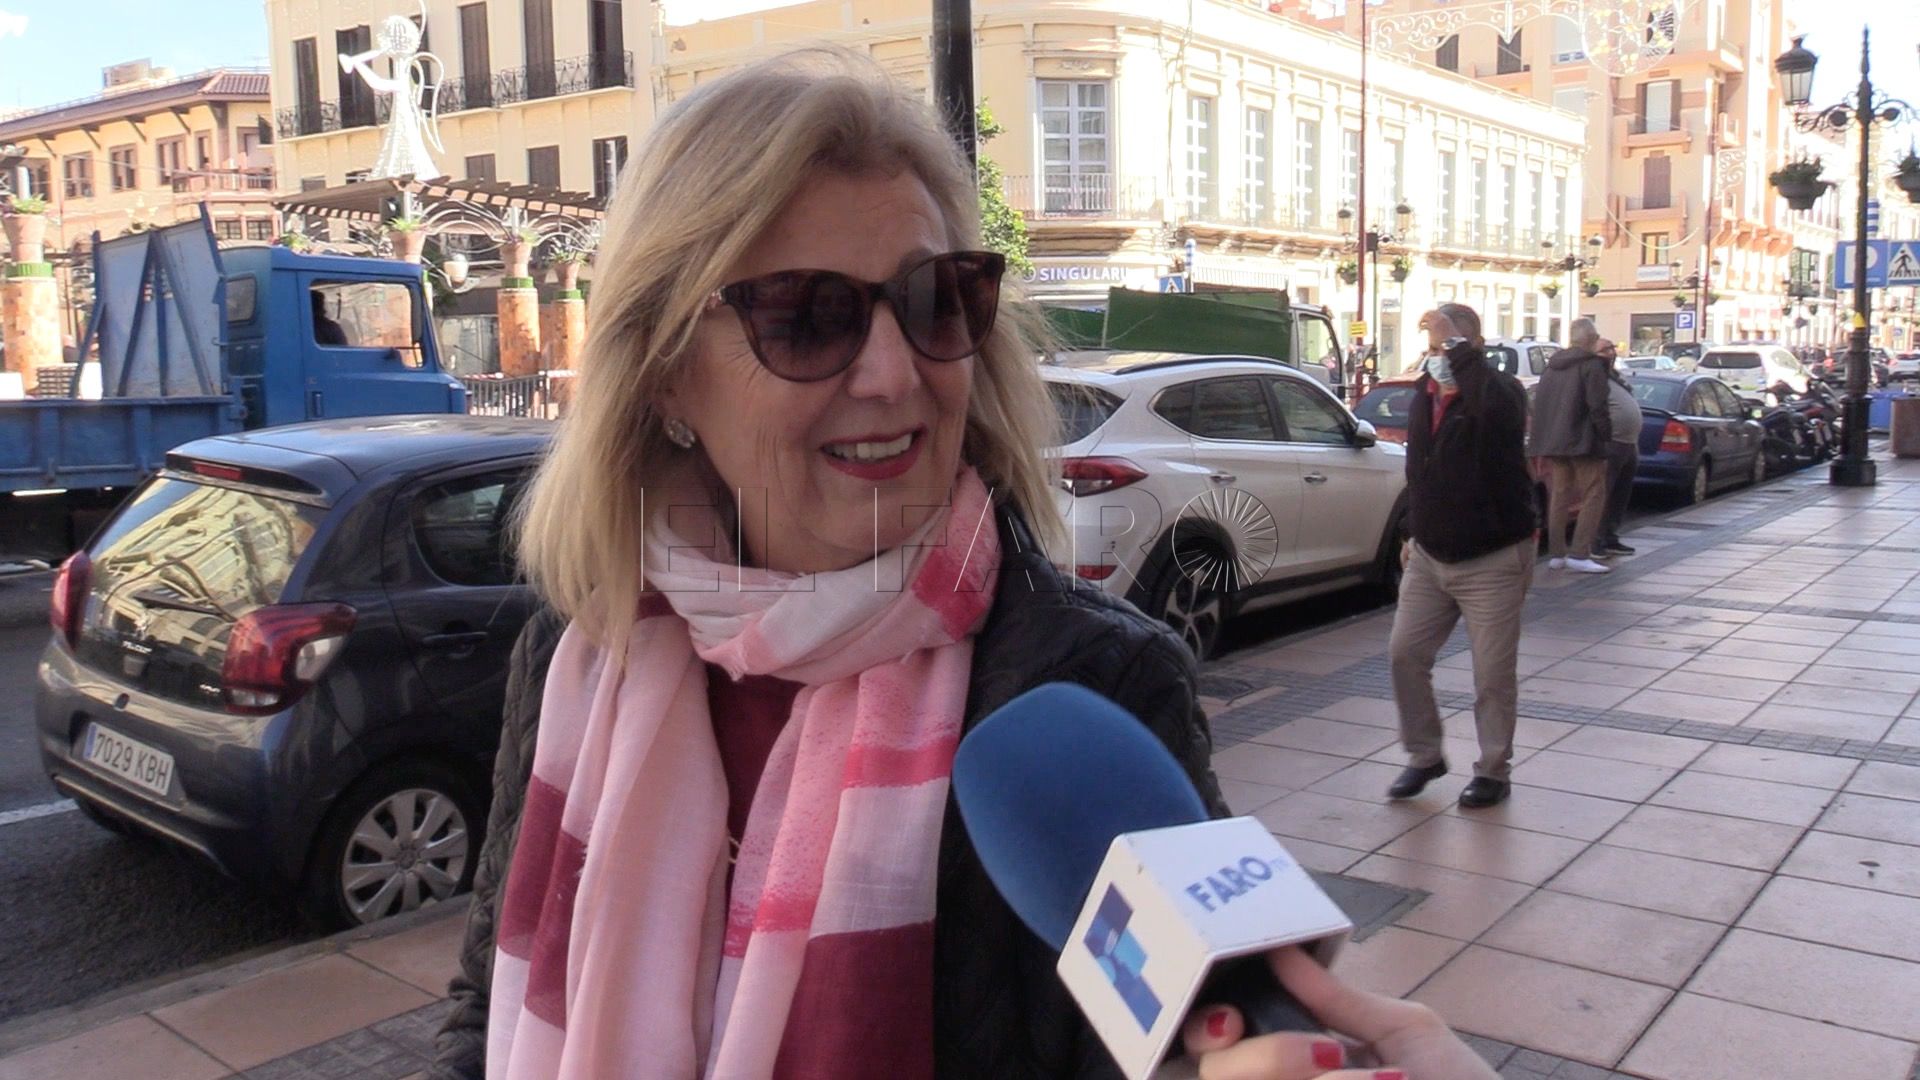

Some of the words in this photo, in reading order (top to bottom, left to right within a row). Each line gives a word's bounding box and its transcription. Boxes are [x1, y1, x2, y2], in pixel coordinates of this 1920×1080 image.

[1678, 313, 1692, 328] P
[95, 734, 134, 773] 7029
[134, 754, 170, 794] KBH
[1185, 856, 1272, 912] FARO
